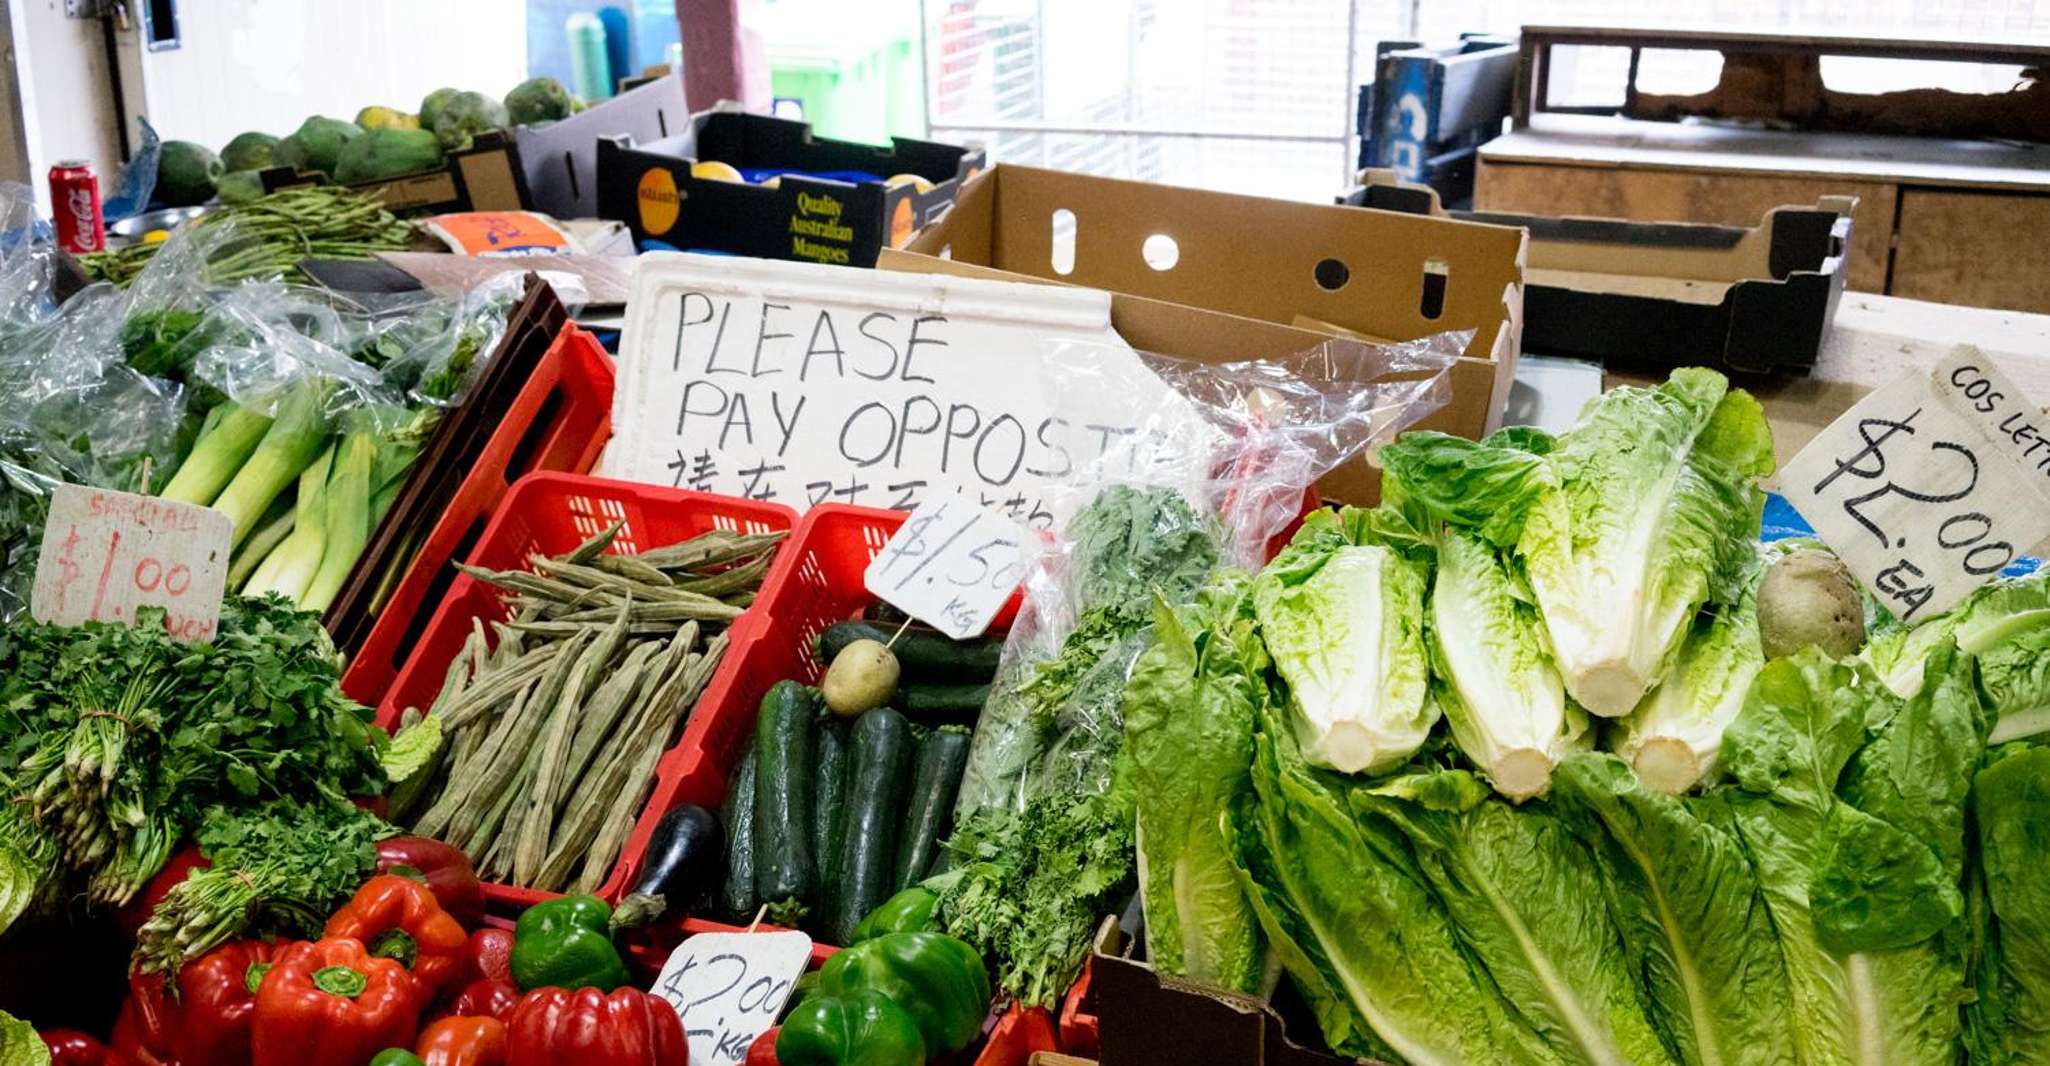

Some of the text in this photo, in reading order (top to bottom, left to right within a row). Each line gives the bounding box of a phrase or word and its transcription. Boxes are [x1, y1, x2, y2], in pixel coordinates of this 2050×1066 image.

[789, 215, 853, 241] Australian
[797, 191, 842, 219] Quality
[792, 236, 849, 263] Mangoes
[673, 291, 949, 384] PLEASE
[676, 379, 806, 458] PAY
[1951, 366, 2050, 478] COS LETT
[1813, 407, 2014, 576] $2.00
[56, 523, 192, 621] $1.00
[1875, 558, 1935, 621] EA
[940, 595, 978, 635] KG
[711, 1028, 754, 1061] KG
